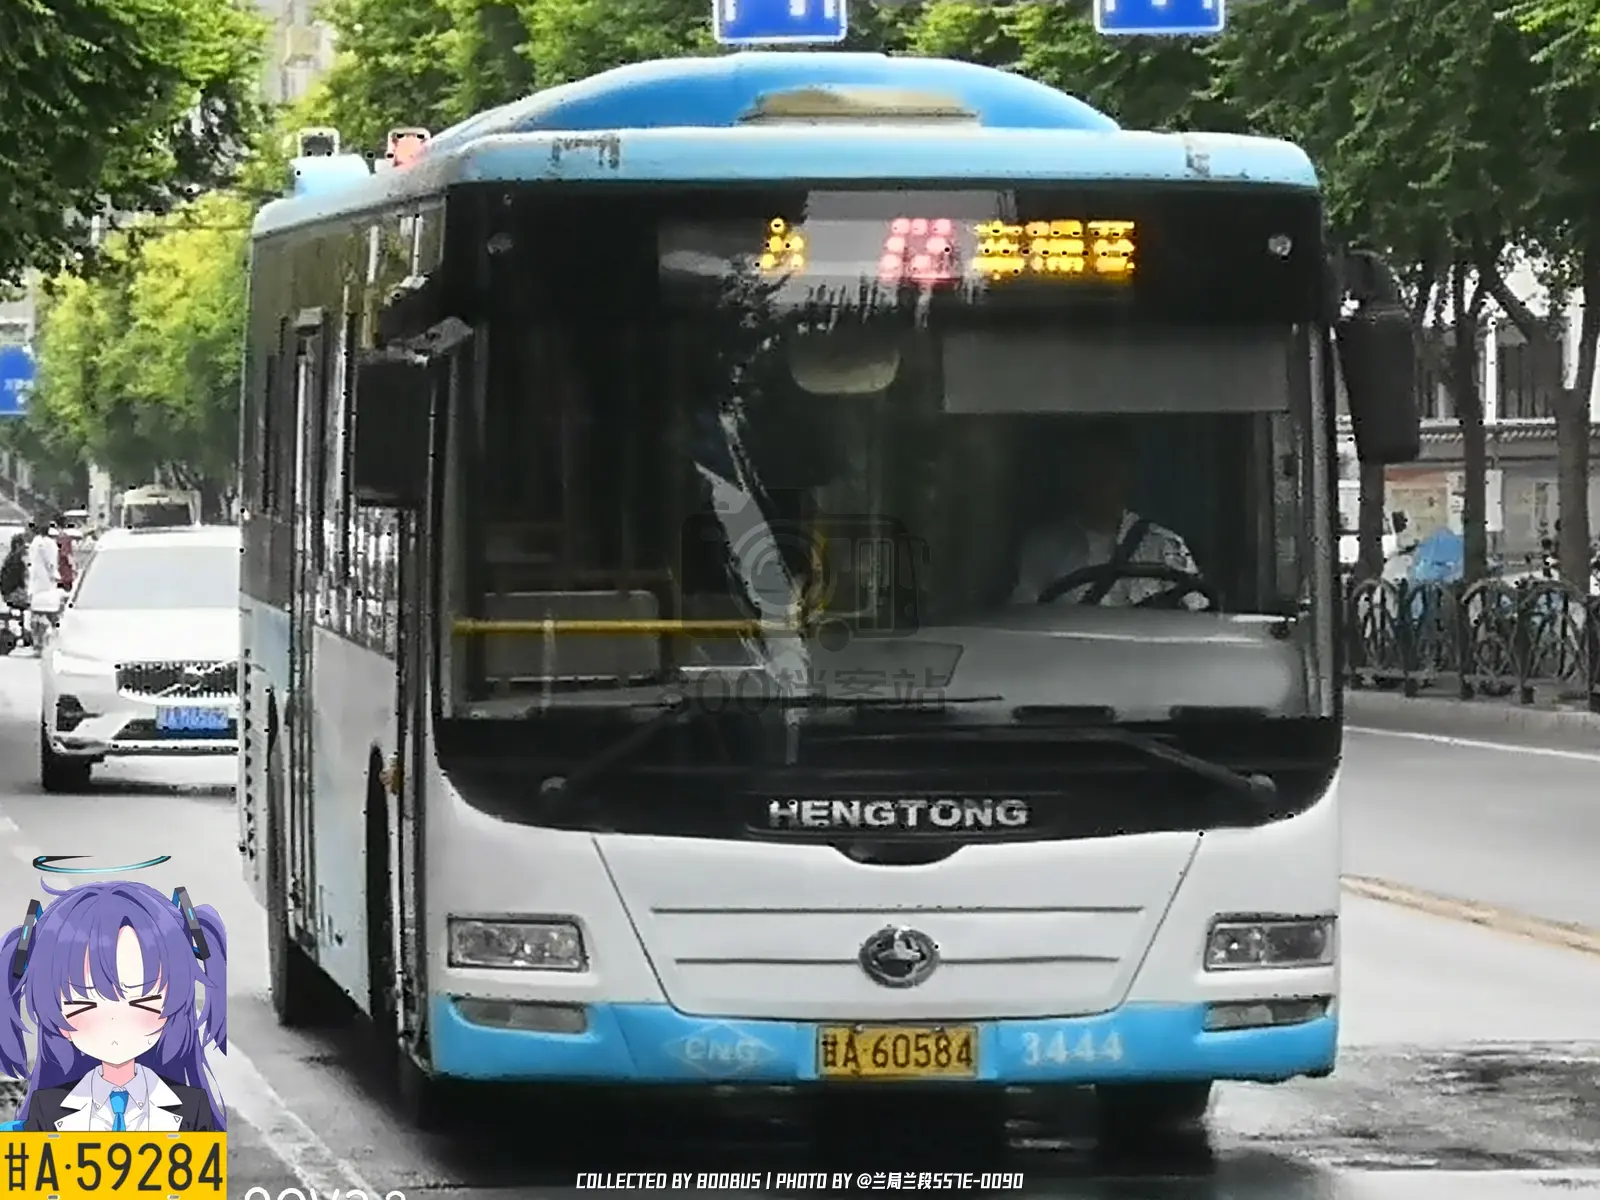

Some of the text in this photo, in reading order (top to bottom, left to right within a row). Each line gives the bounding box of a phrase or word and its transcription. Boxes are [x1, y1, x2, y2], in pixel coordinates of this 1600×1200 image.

[768, 799, 1029, 828] HENGTONG
[684, 1037, 760, 1063] CNG
[1024, 1032, 1123, 1065] 3444
